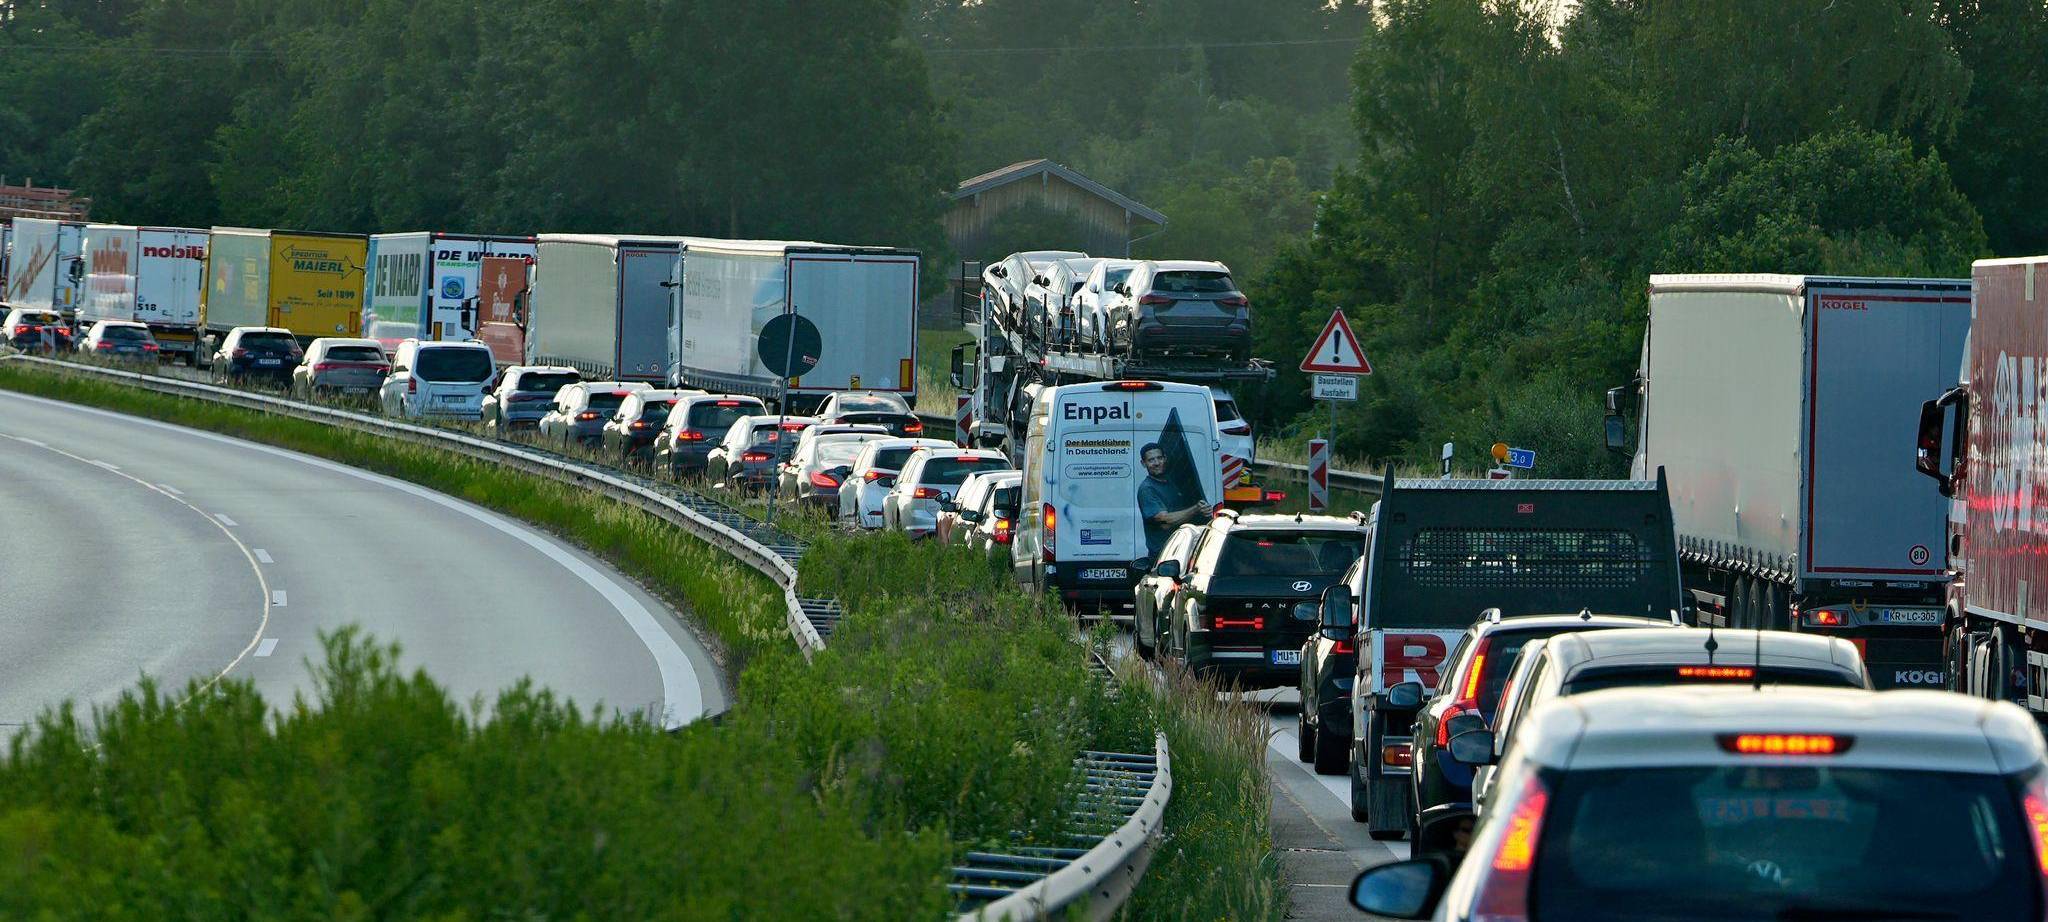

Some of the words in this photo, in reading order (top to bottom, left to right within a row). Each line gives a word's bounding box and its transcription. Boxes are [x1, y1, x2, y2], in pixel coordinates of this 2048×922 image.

[144, 245, 204, 259] nobili
[438, 250, 462, 260] DE
[294, 260, 345, 272] MAIERL
[1317, 375, 1353, 385] Baustellen
[1320, 388, 1350, 397] Ausfahrt
[1914, 550, 1925, 560] 80
